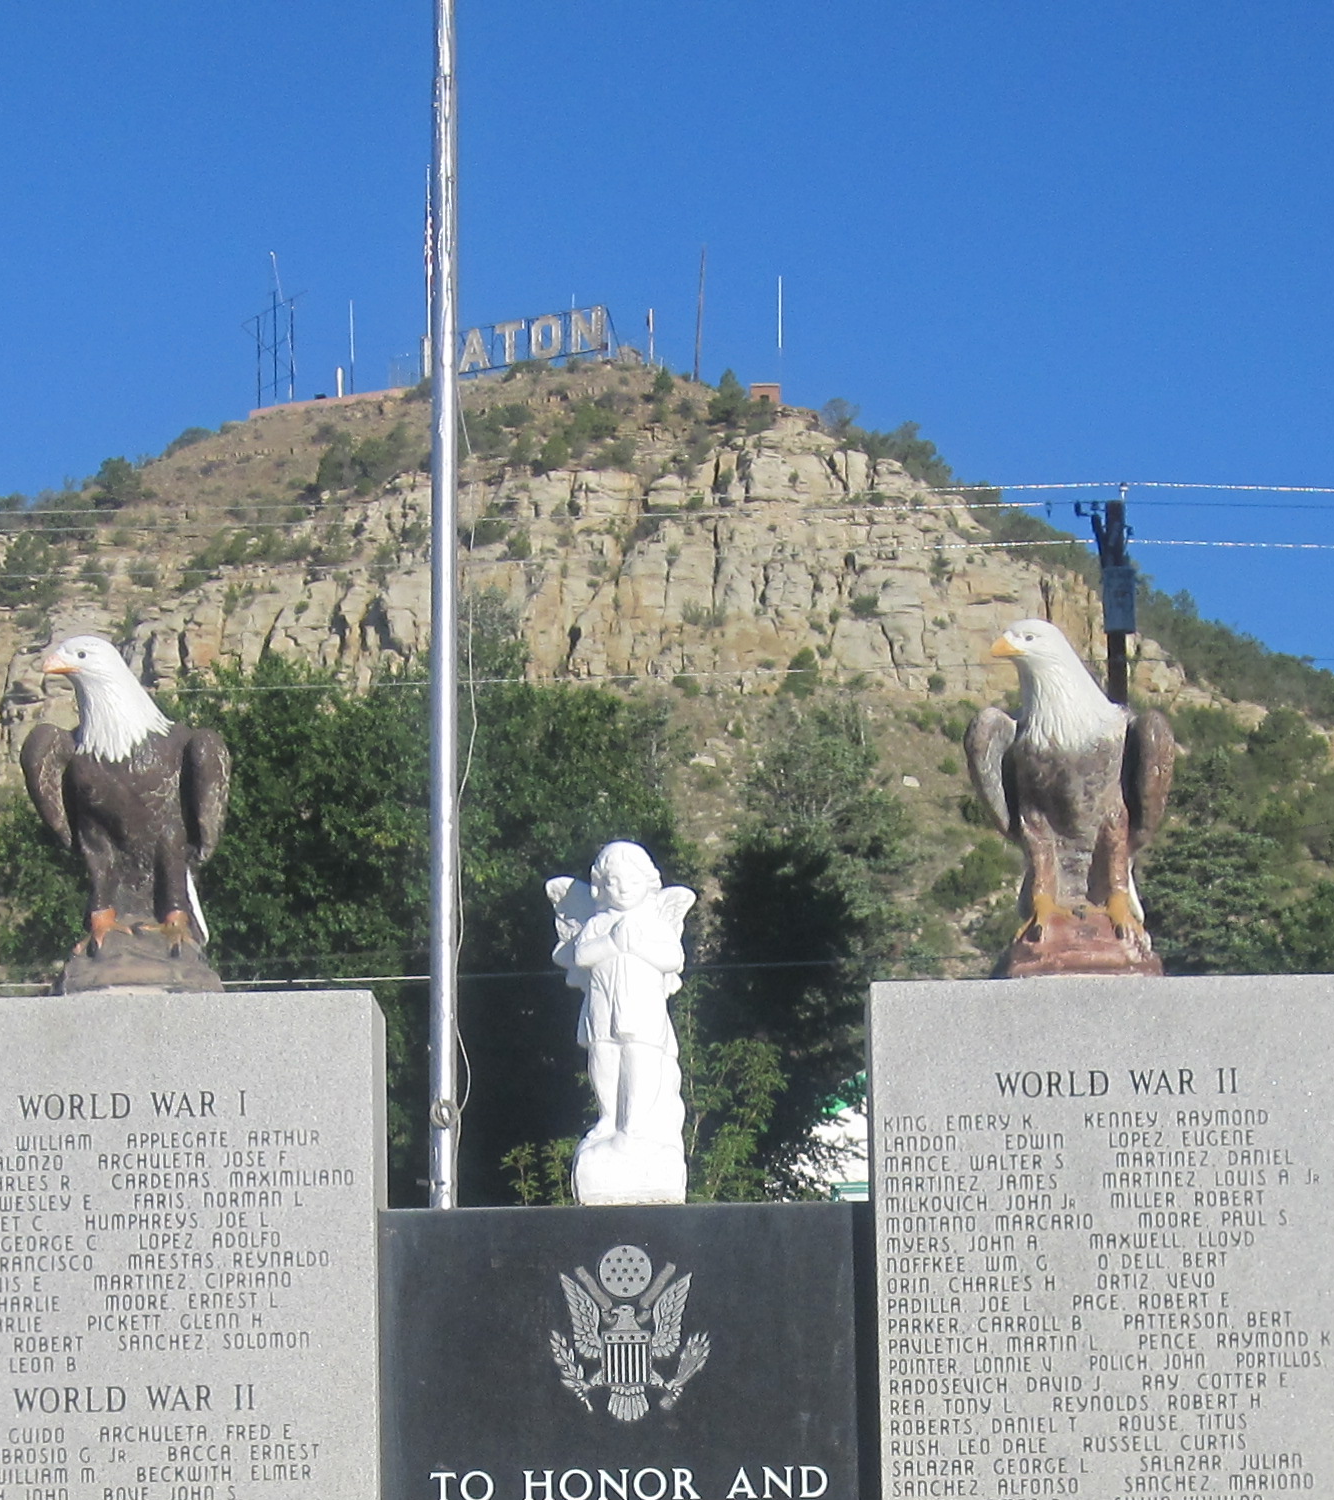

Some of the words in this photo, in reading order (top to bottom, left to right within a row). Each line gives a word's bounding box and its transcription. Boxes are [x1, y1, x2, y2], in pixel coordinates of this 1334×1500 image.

[424, 306, 607, 377] ATON
[995, 1070, 1110, 1099] WORLD
[1128, 1068, 1195, 1096] WAR
[1217, 1067, 1237, 1094] II
[18, 1092, 131, 1121] WORLD
[150, 1090, 217, 1119] WAR
[239, 1089, 246, 1117] I
[15, 1133, 92, 1153] WILLIAM
[247, 1129, 320, 1148] ARTHUR
[1005, 1132, 1064, 1151] EDWIN
[1181, 1128, 1254, 1148] EUGENE
[223, 1149, 267, 1169] JOSE
[232, 1249, 330, 1269] REYNALDO
[204, 1270, 292, 1290] CIPRIANO
[188, 1291, 258, 1310] ERNEST
[978, 1294, 1011, 1314] JOE
[1138, 1291, 1209, 1311] ROBERT
[977, 1314, 1062, 1334] CARROLL
[1246, 1310, 1292, 1329] BERT
[13, 1335, 84, 1354] ROBERT
[222, 1330, 310, 1350] SOLOMON
[9, 1355, 55, 1374] LEON
[13, 1385, 127, 1414] WORLD
[146, 1384, 212, 1412] WAR
[235, 1383, 254, 1412] II
[991, 1416, 1058, 1435] DANIEL
[1196, 1412, 1247, 1431] TITUS
[958, 1437, 991, 1457] LEO
[1002, 1436, 1047, 1455] DALE
[1180, 1433, 1246, 1452] CURTIS
[250, 1463, 312, 1482] ELMER
[726, 1465, 828, 1499] AND
[997, 1476, 1079, 1496] ALFONSO
[1228, 1472, 1314, 1493] MARIONO
